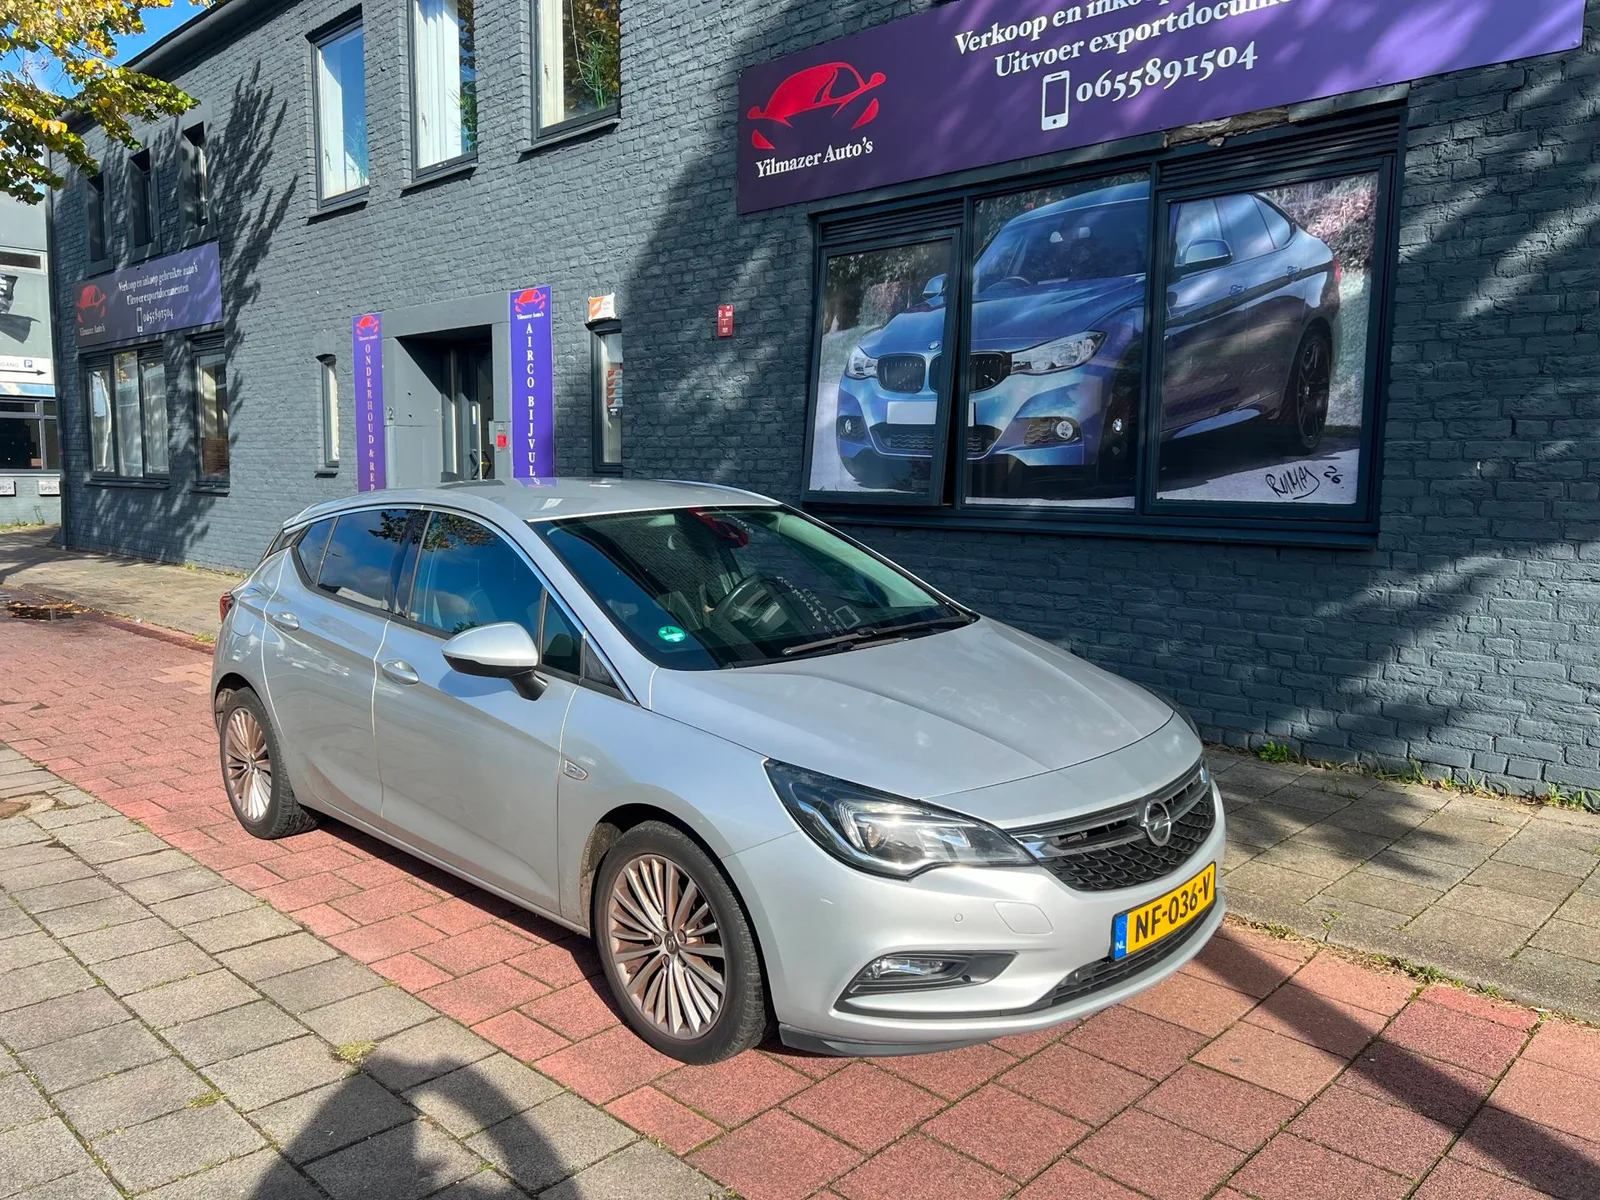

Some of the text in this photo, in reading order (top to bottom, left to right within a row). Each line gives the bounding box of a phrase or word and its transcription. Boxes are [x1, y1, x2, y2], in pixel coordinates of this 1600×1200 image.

[955, 16, 1048, 55] Verkoop
[1052, 6, 1083, 27] en
[994, 40, 1085, 77] Uitvoer
[1076, 41, 1258, 102] 0655891504
[755, 136, 874, 178] Yilmazer Auto's
[526, 322, 535, 388] AIRCO
[364, 343, 374, 444] ONDERHOUD
[1135, 872, 1211, 943] NF-036-V
[1115, 941, 1125, 951] NL
